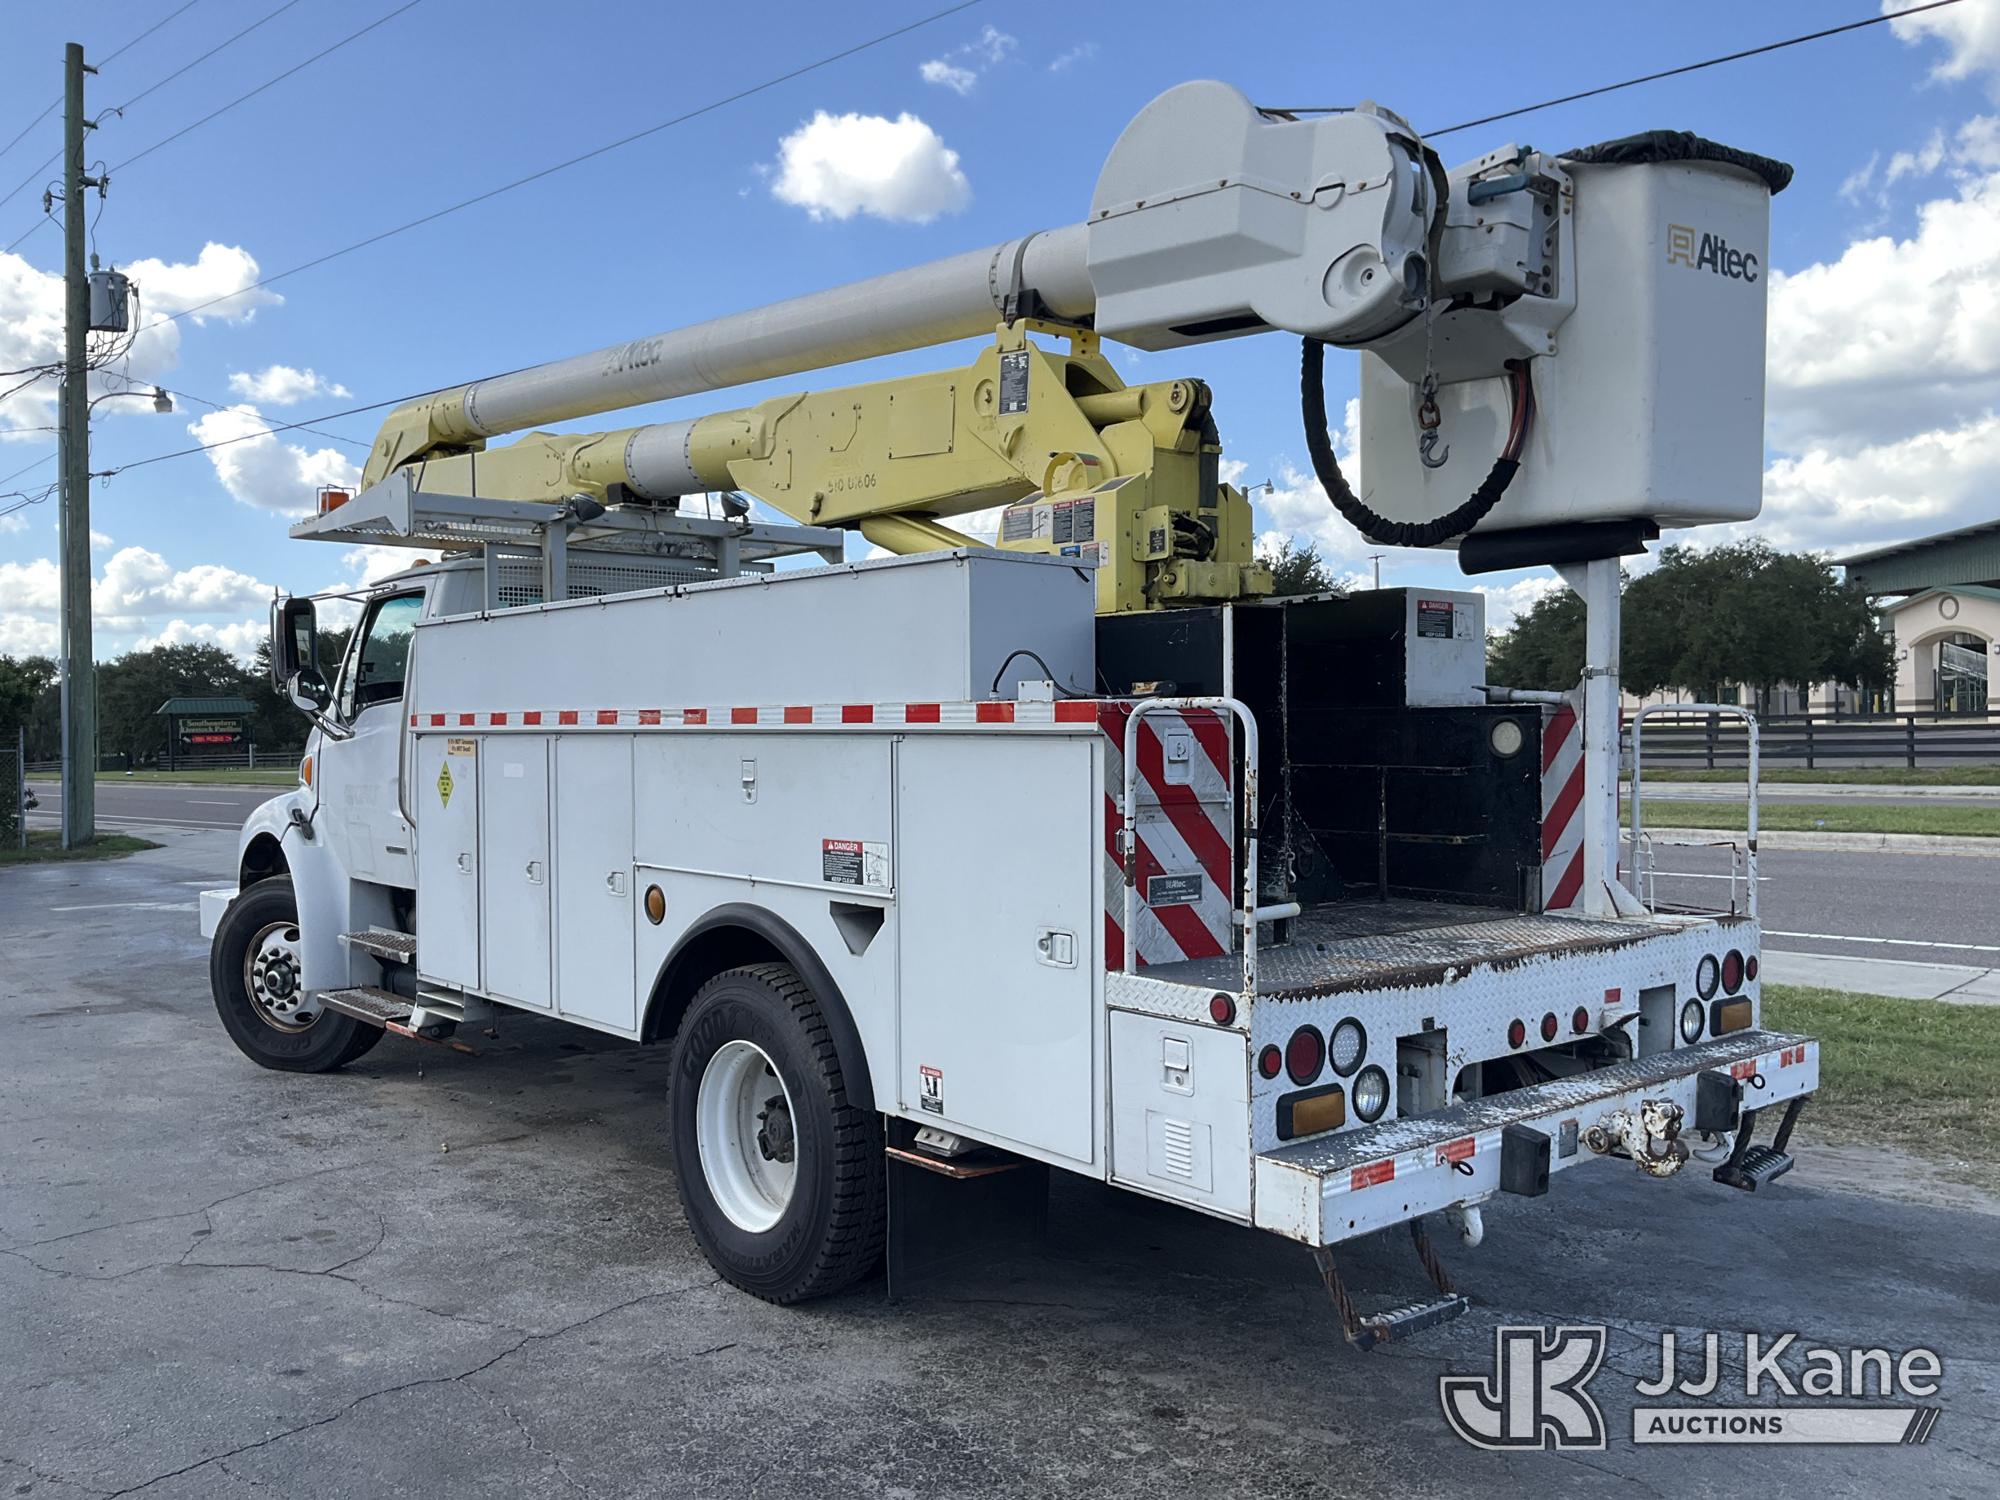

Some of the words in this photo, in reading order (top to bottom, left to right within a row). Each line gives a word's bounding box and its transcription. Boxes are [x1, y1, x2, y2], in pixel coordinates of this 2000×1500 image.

[1697, 232, 1757, 282] Altec
[1428, 601, 1449, 609] DANGER
[834, 842, 858, 851] DANGER
